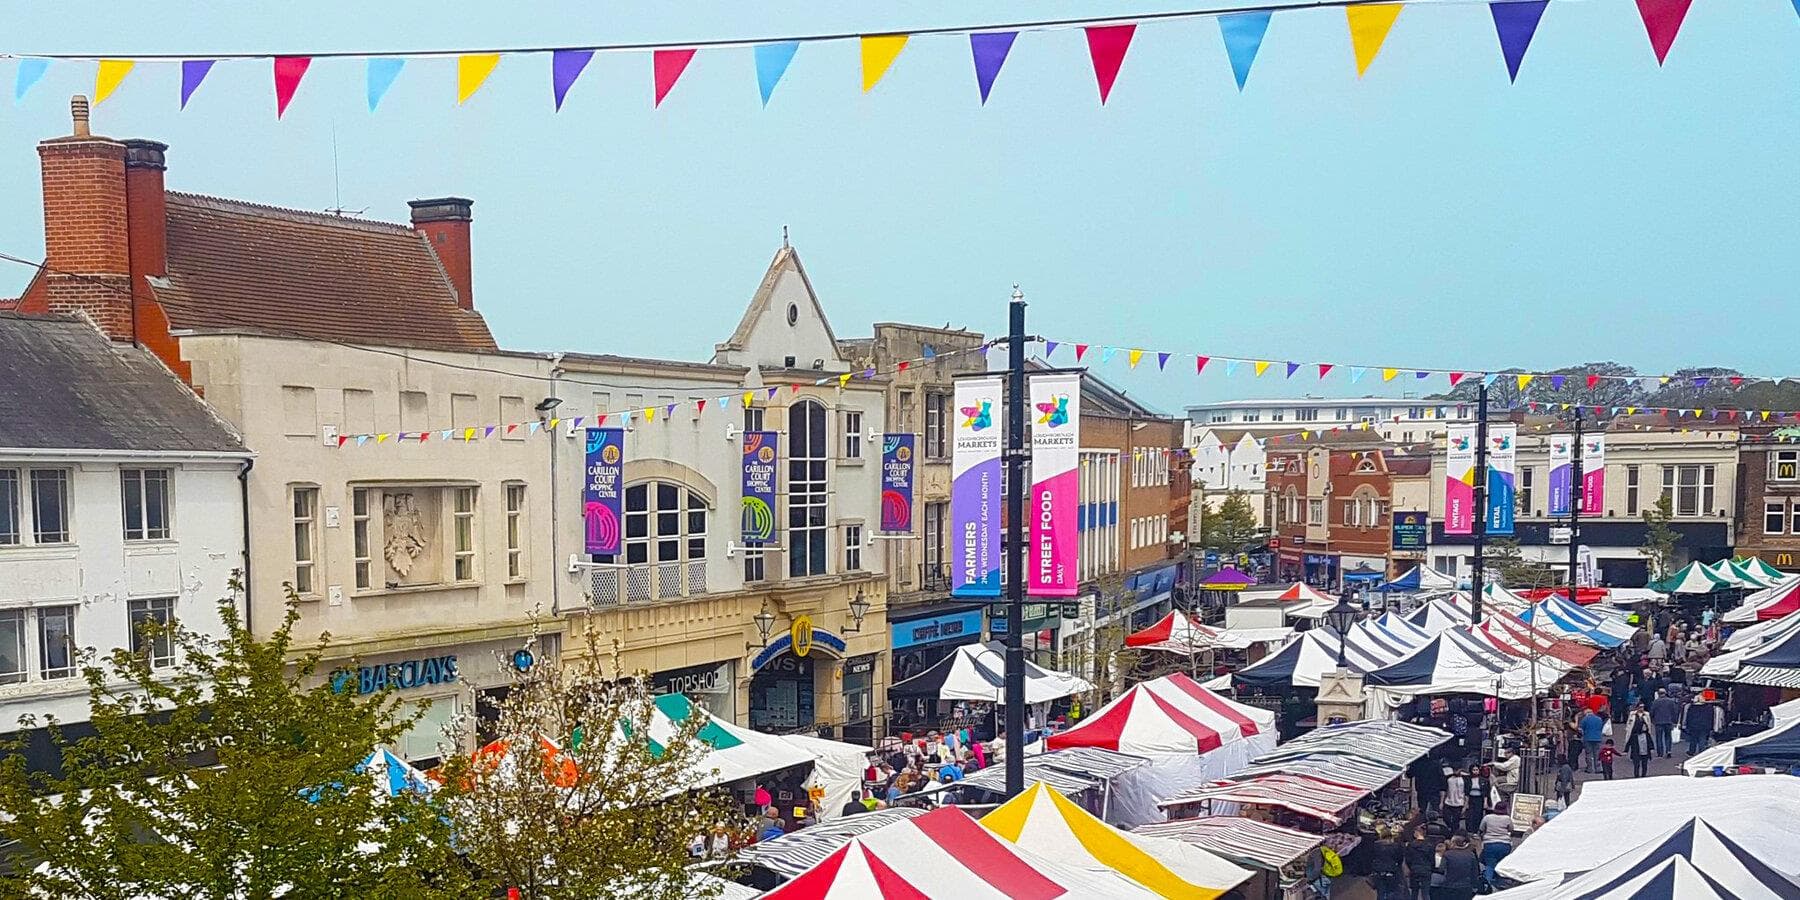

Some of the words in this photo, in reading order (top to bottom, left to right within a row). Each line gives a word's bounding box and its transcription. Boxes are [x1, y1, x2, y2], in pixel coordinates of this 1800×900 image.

[588, 466, 620, 476] CARILLON
[745, 465, 774, 473] CARILLON
[594, 475, 616, 484] COURT
[750, 473, 770, 481] COURT
[599, 490, 617, 498] CENTRE
[1041, 490, 1052, 530] FOOD
[965, 522, 976, 584] FARMERS
[1041, 534, 1052, 584] STREET
[852, 664, 870, 673] NEWS
[358, 656, 458, 695] BARCLAYS
[669, 671, 720, 694] TOPSHOP
